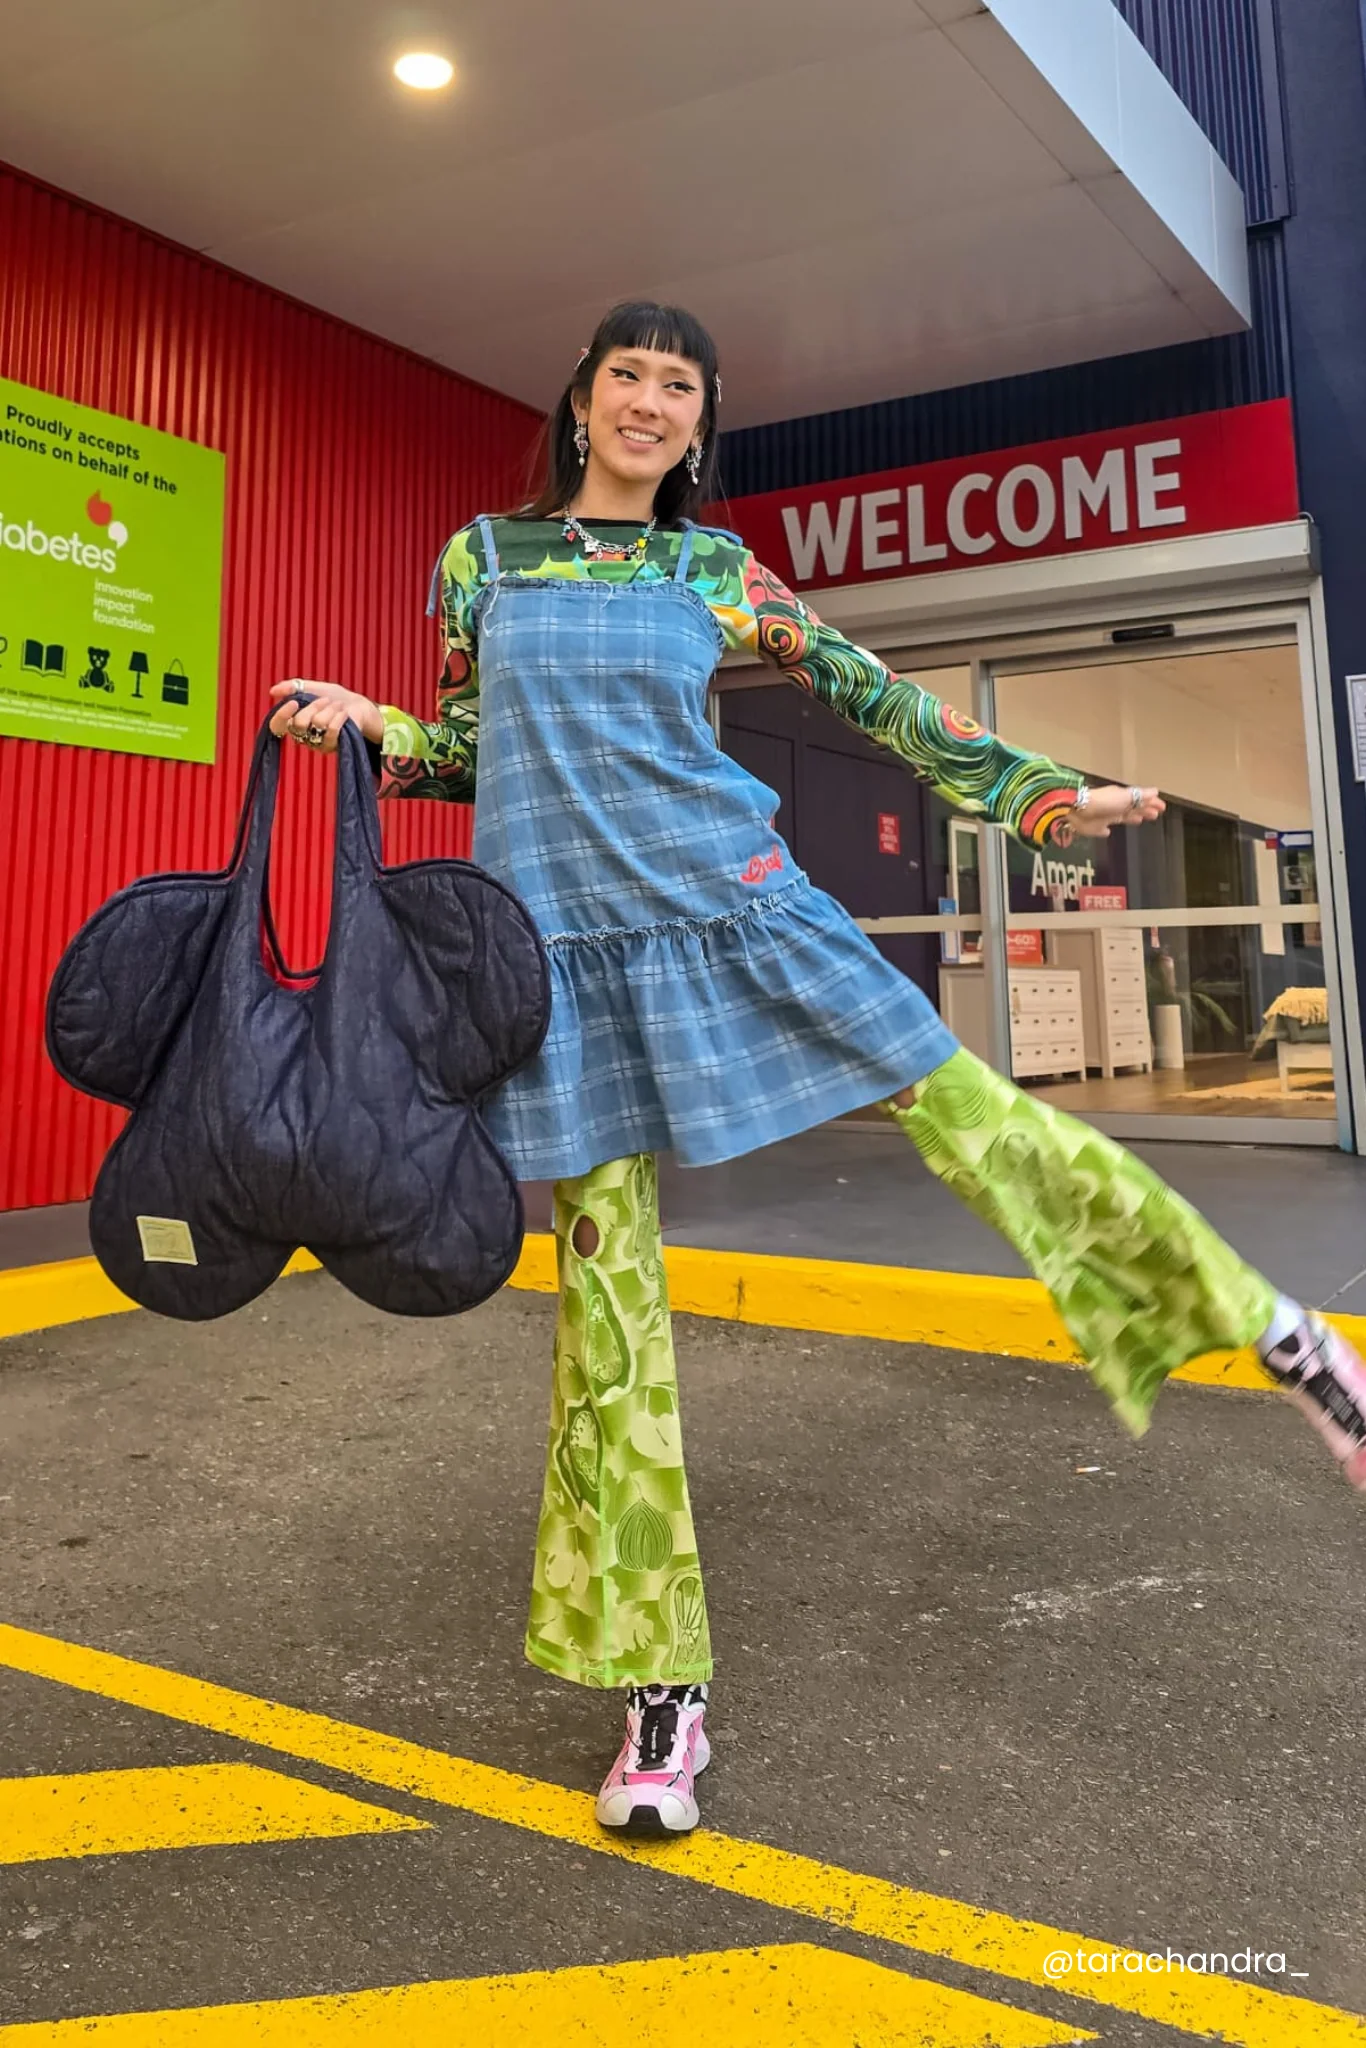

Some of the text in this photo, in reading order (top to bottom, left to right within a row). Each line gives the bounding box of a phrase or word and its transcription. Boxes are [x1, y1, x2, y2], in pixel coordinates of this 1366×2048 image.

[7, 405, 140, 461] Proudly accepts
[52, 446, 73, 464] on
[78, 450, 129, 479] behalf
[133, 471, 149, 486] of
[153, 476, 177, 495] the
[781, 438, 1187, 581] WELCOME
[93, 592, 135, 615] impact
[94, 577, 154, 604] innovation
[93, 609, 155, 634] foundation
[1030, 852, 1095, 900] Amart
[1084, 895, 1123, 909] FREE
